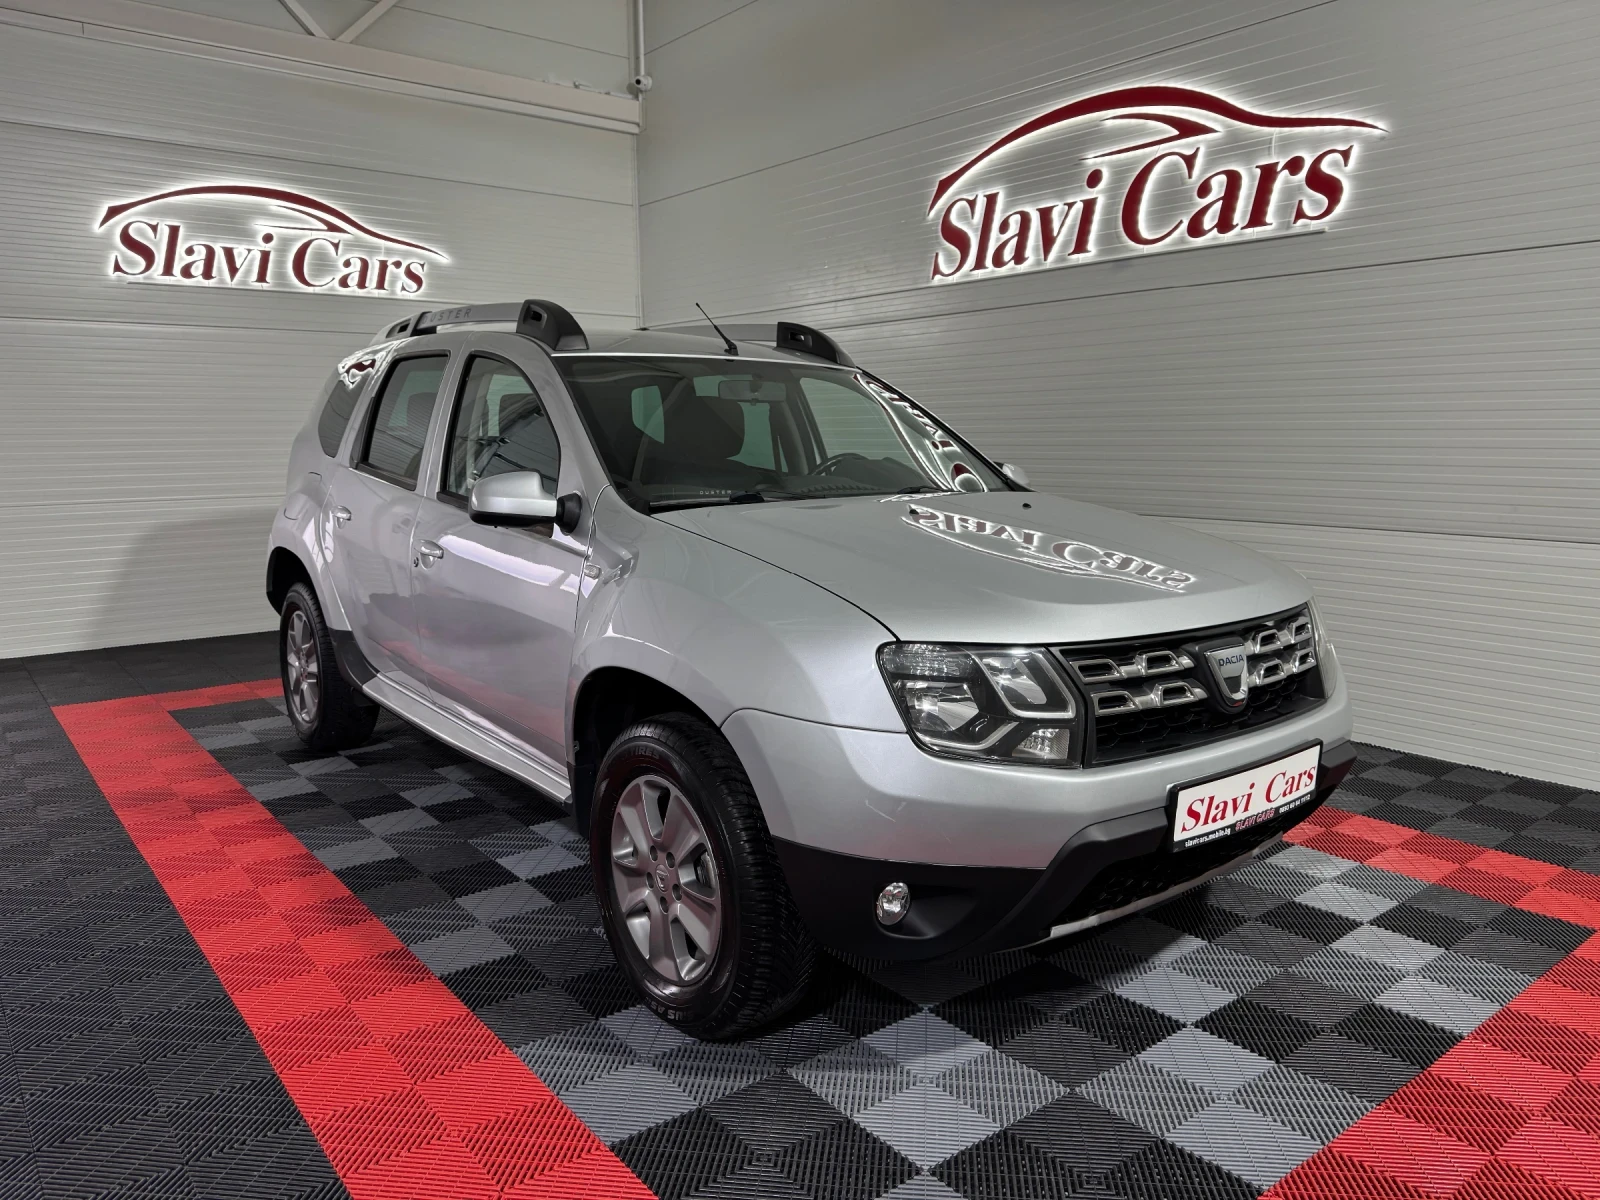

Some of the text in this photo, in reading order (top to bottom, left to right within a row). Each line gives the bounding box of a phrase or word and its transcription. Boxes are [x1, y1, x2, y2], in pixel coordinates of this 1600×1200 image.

[932, 144, 1355, 281] Slavi Cars
[112, 220, 426, 294] Slavi Cars
[1218, 654, 1245, 667] DACIA
[1180, 765, 1316, 834] Slavi Cars
[1235, 807, 1275, 832] SLAVI CARS
